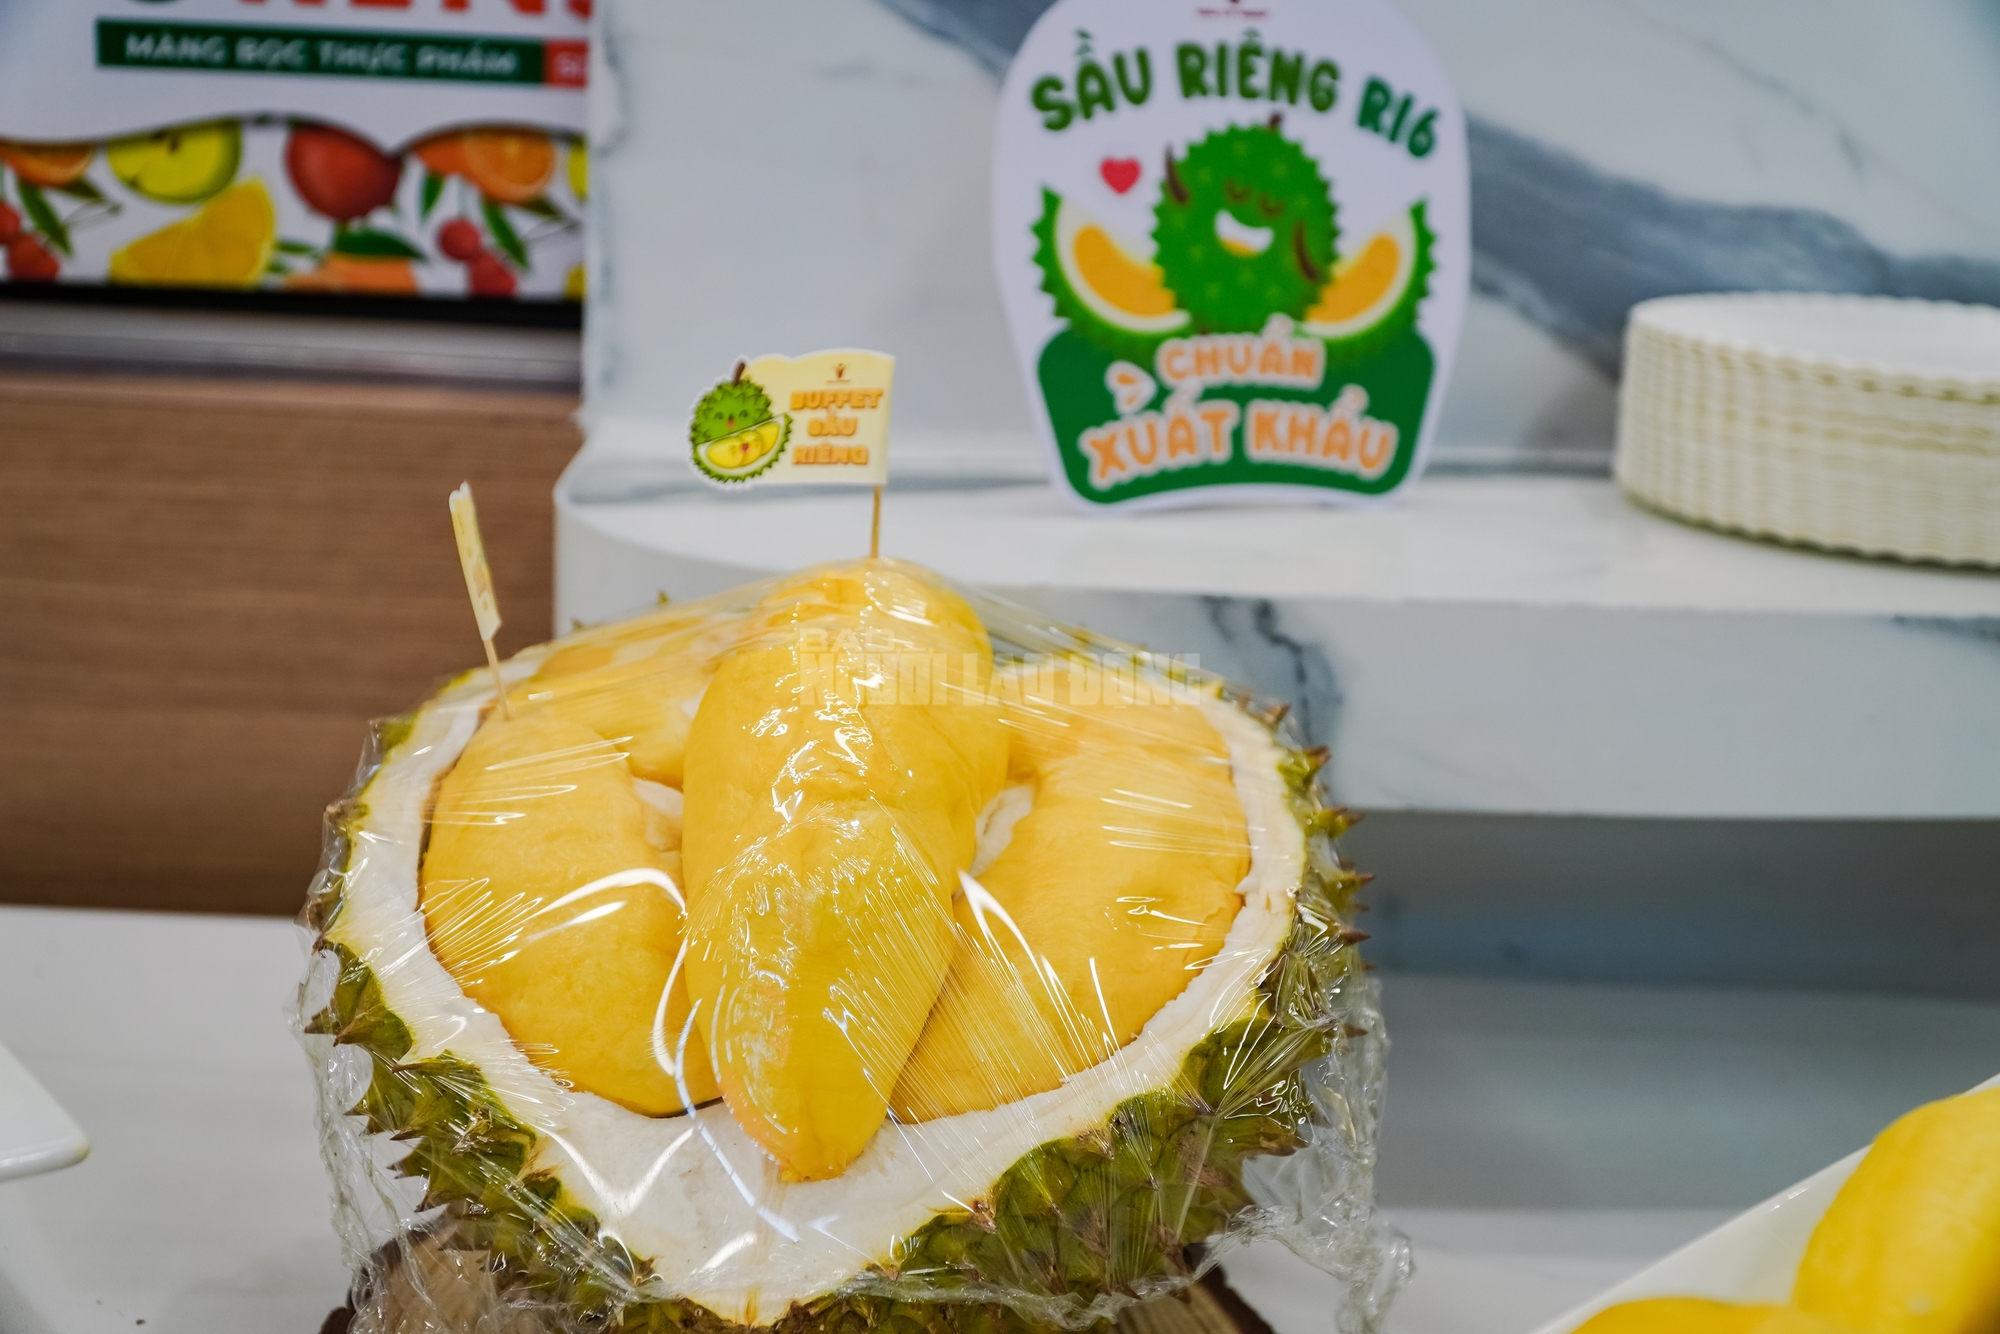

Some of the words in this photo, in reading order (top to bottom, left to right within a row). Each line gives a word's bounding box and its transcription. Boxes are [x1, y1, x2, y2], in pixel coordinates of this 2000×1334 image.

[1030, 29, 1151, 131] SẦU
[1175, 28, 1340, 112] RIÊNG
[790, 389, 883, 411] BUFFET
[792, 441, 869, 466] RIÊNG
